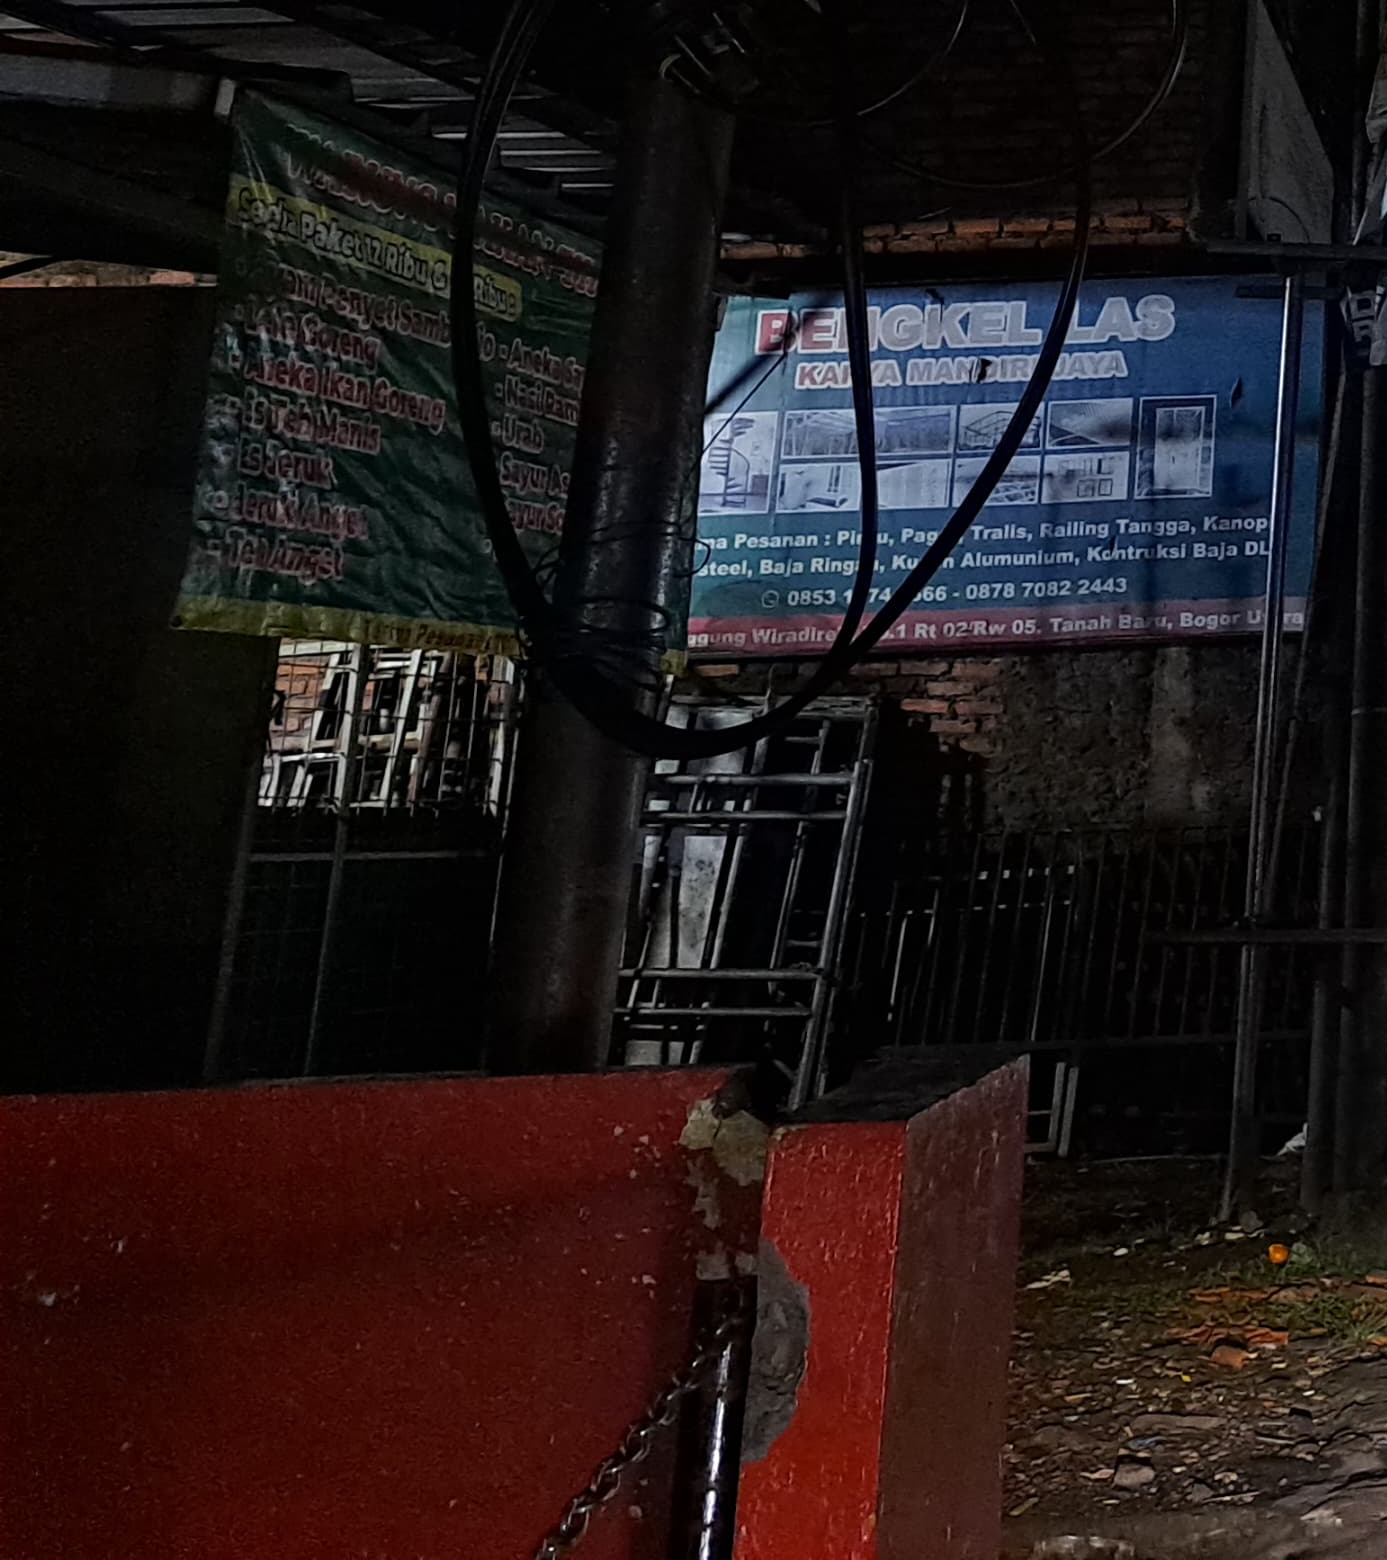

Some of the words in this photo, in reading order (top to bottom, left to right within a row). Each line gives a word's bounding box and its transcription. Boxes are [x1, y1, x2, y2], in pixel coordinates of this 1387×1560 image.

[300, 211, 363, 260] Paket
[384, 243, 430, 285] Ribu
[1066, 295, 1176, 344] LAS
[300, 311, 384, 376] Goreng
[506, 337, 562, 388] Aneka
[906, 354, 1035, 386] MANDIR
[319, 363, 371, 411] Ikan
[371, 376, 446, 436] Goreng
[543, 387, 580, 427] Ram
[314, 401, 382, 457] Manis
[502, 413, 544, 455] Urab
[263, 438, 338, 490] Jeruk
[499, 452, 548, 496] Sayur
[734, 532, 818, 550] Pesanan
[837, 528, 894, 547] Piu,
[901, 526, 964, 547] Pag,
[971, 523, 1032, 541] Tralis,
[1040, 518, 1109, 539] Railing
[1115, 516, 1197, 536] Tangga,
[1203, 514, 1272, 533] Kanop
[759, 557, 804, 576] Baja
[810, 556, 885, 575] Ring,
[892, 552, 954, 571] Kun
[960, 549, 1081, 570] Alumunium,
[1193, 539, 1235, 559] Baja
[787, 589, 836, 606] 0853
[845, 587, 891, 605] 174
[966, 582, 1014, 600] 0878
[1022, 579, 1070, 597] 7082
[1077, 577, 1127, 595] 2443
[752, 624, 845, 645] Wiradire
[914, 622, 937, 639] Rt
[1011, 618, 1042, 635] 05.
[1049, 614, 1112, 634] Tanah
[1180, 610, 1240, 630] Bogor
[1246, 608, 1304, 626] Ura
